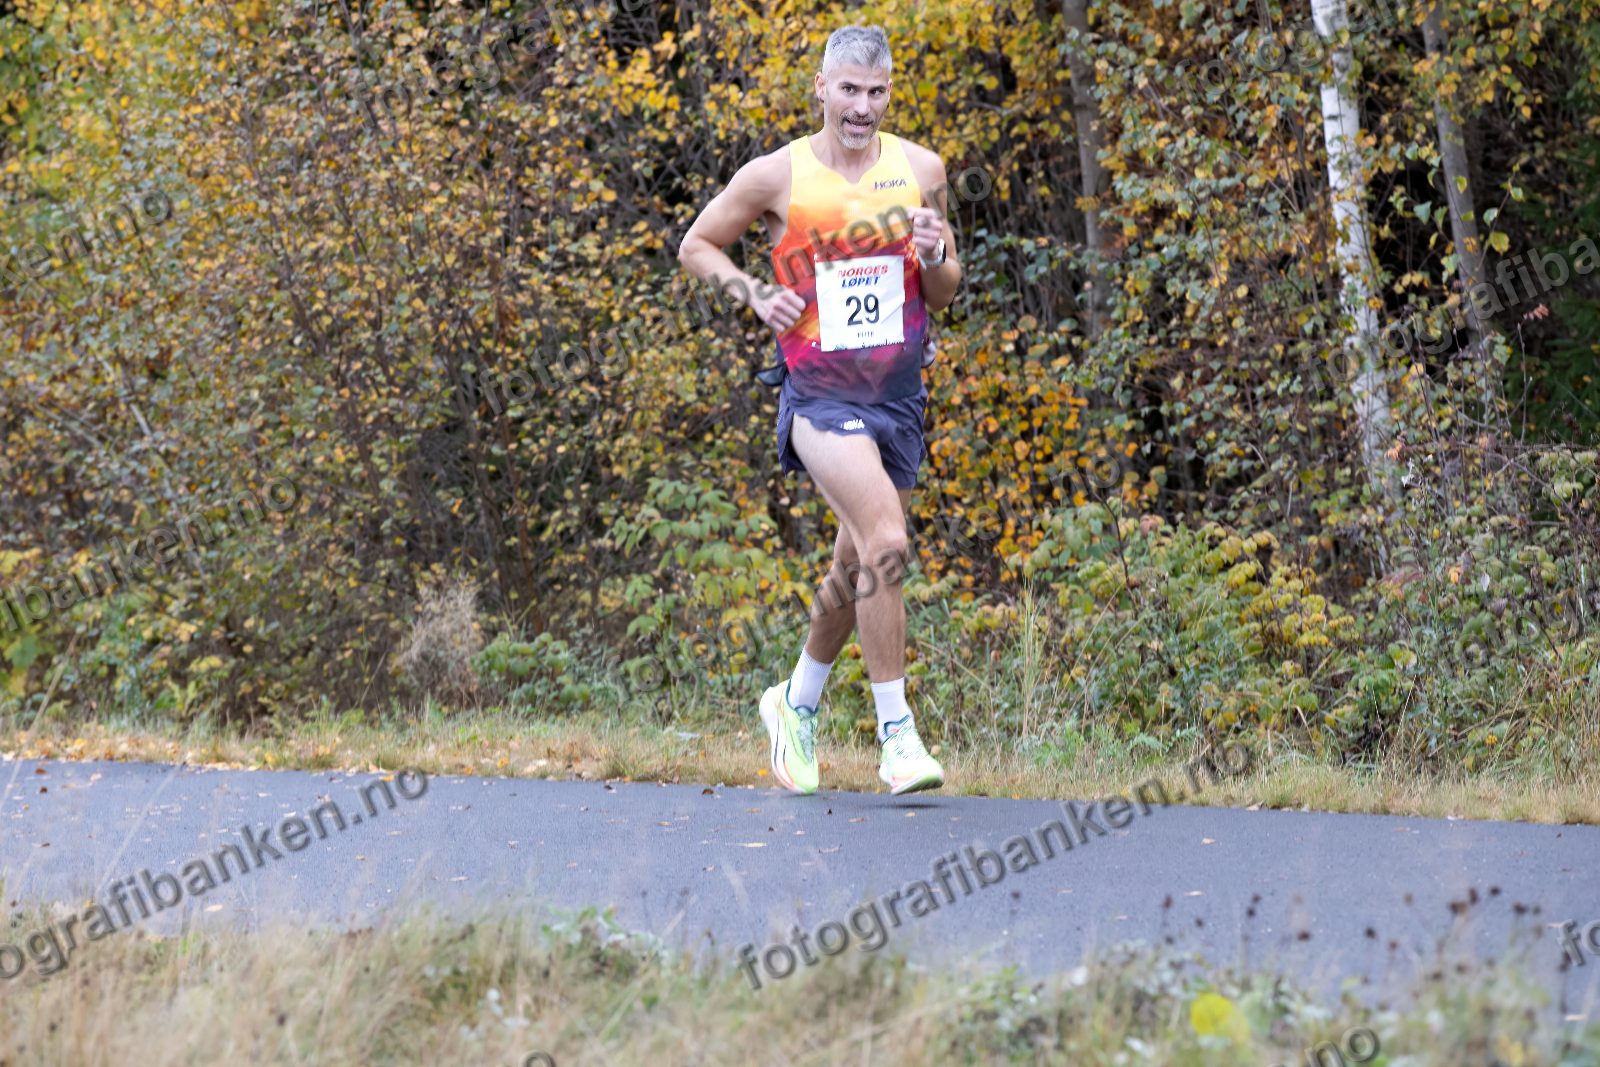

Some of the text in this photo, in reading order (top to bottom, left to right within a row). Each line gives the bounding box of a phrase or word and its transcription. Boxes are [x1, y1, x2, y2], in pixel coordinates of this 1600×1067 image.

[839, 264, 888, 277] NORGES
[842, 275, 880, 288] LØPET
[846, 293, 879, 326] 29
